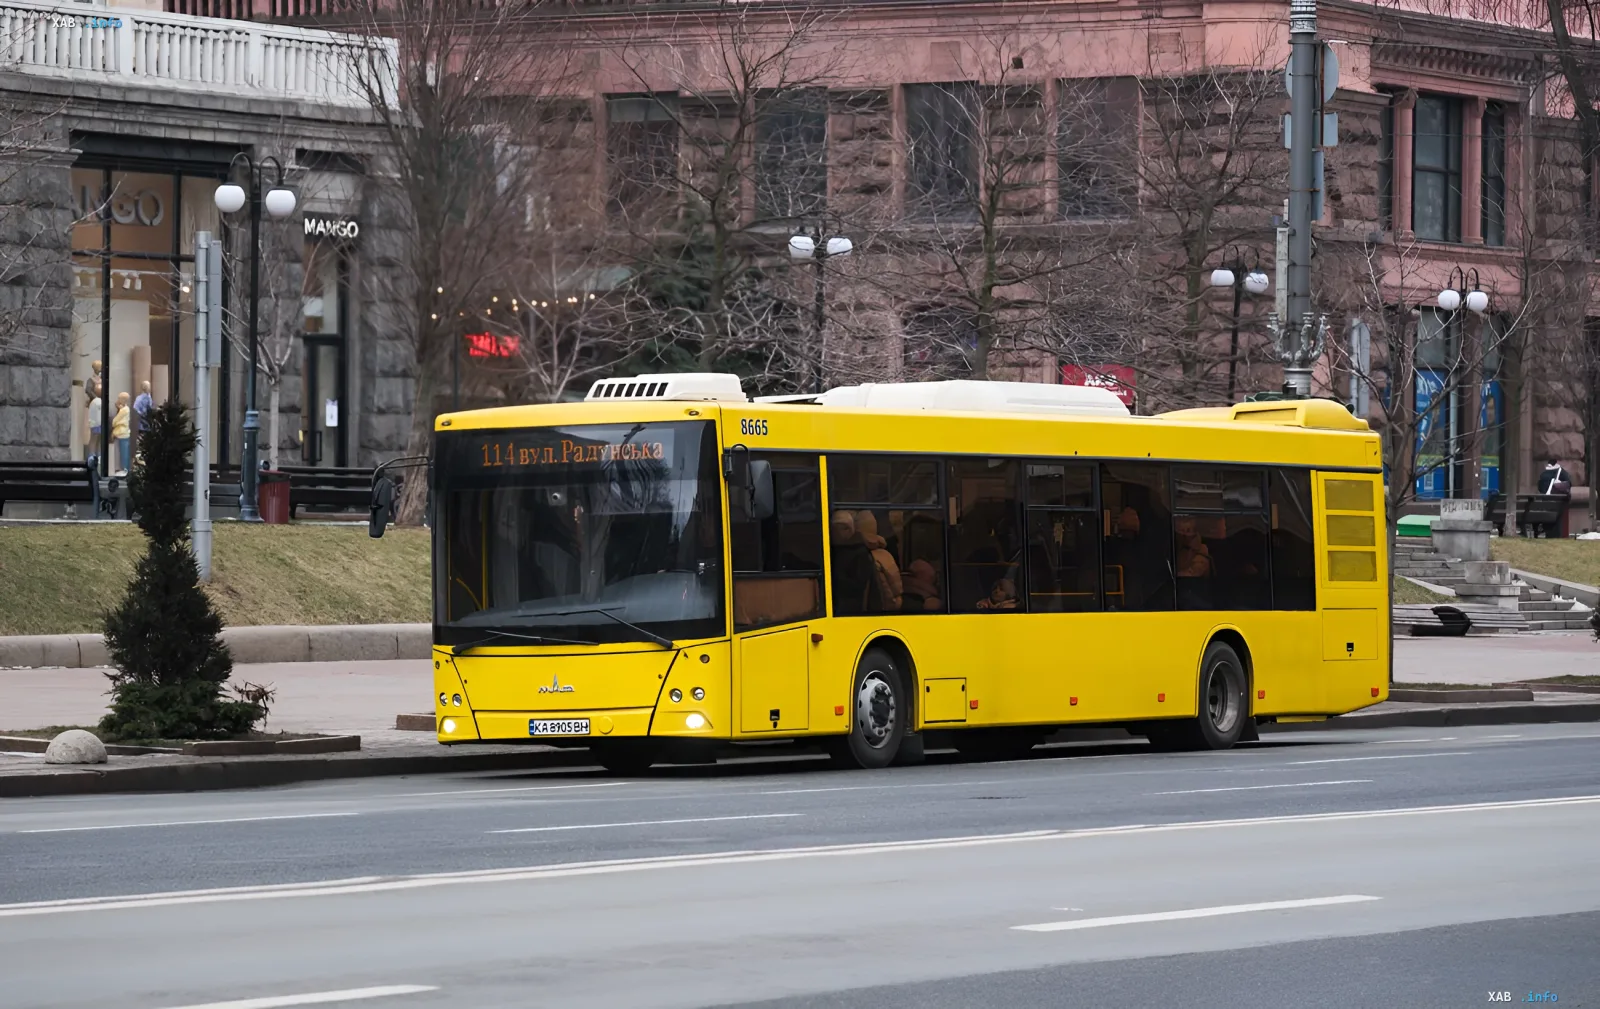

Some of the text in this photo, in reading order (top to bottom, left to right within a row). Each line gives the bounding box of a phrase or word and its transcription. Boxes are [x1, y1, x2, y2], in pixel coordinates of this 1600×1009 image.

[304, 217, 359, 238] MANGO
[741, 418, 768, 436] 8665
[481, 442, 515, 467] 114
